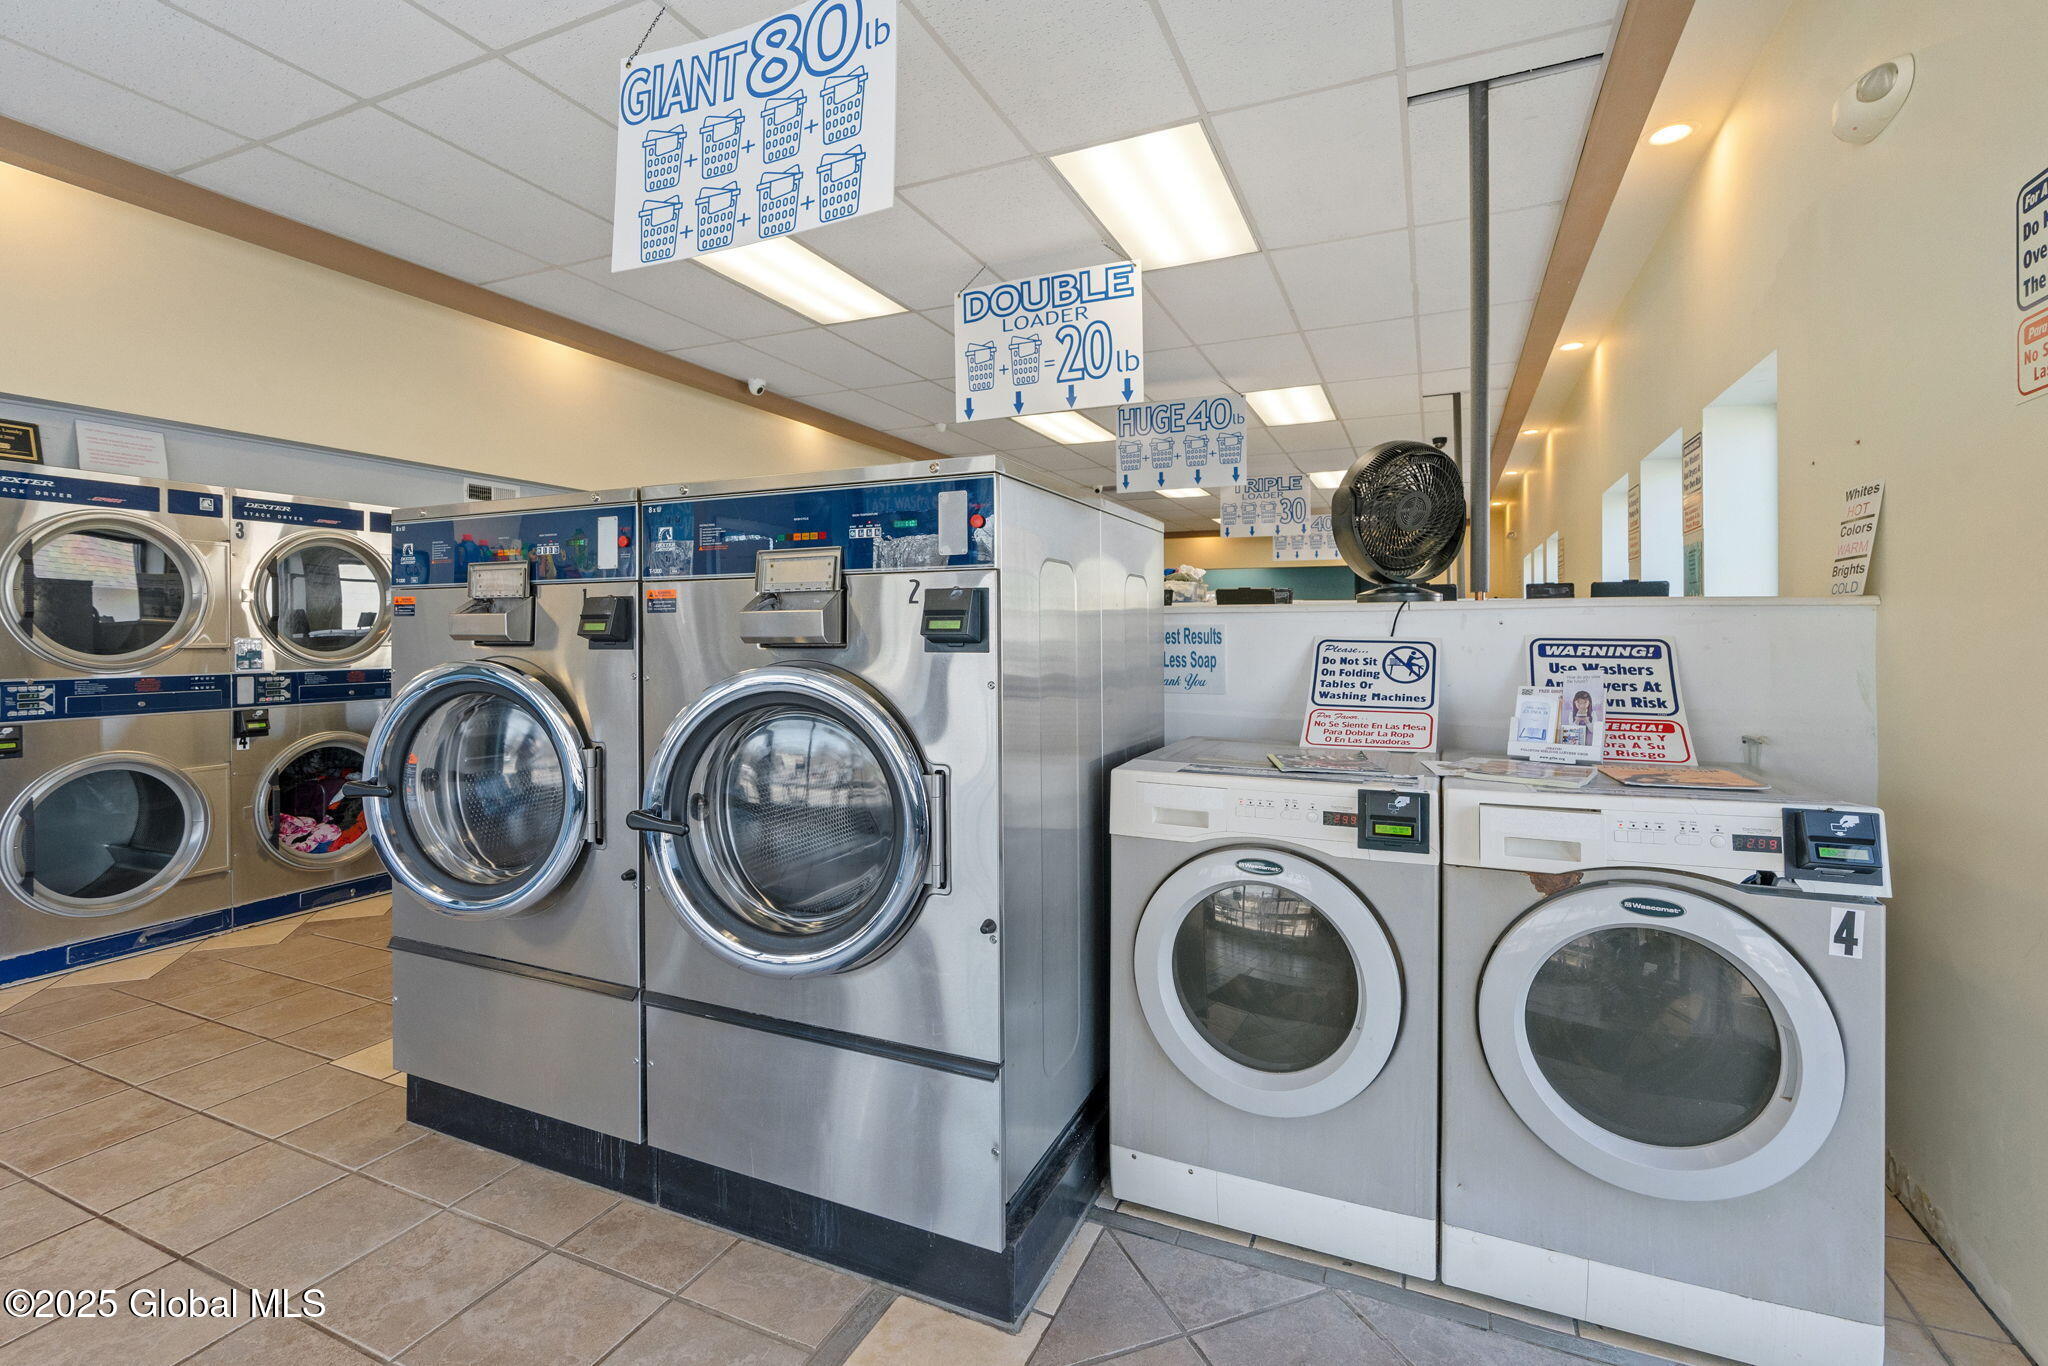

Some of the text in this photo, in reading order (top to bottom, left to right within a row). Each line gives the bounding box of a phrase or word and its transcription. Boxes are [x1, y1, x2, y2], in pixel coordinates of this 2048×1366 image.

[621, 0, 891, 125] GIANT 80 lb
[2023, 219, 2039, 242] Do
[2023, 243, 2047, 269] Ove
[2023, 273, 2047, 298] The
[963, 264, 1134, 324] DOUBLE
[1002, 306, 1088, 332] LOADER
[1055, 320, 1140, 383] 20 lb
[2024, 350, 2039, 366] No
[1118, 403, 1185, 437] HUGE
[1186, 398, 1232, 430] 40
[0, 475, 54, 487] EXTER
[35, 490, 73, 499] DRYER
[1242, 491, 1284, 500] LOADER
[1845, 482, 1880, 502] Whites
[244, 502, 292, 512] DEXTER
[1280, 497, 1306, 524] 30
[1847, 502, 1871, 517] HOT
[235, 521, 245, 540] 3
[1840, 521, 1873, 538] Colors
[1837, 540, 1869, 556] WARM
[1832, 563, 1865, 579] Brights
[908, 579, 920, 604] 2
[1832, 581, 1859, 595] COLD
[1165, 627, 1222, 645] est Results
[1544, 645, 1656, 658] WARNING!
[1190, 650, 1217, 672] Soap
[1322, 656, 1378, 666] Do Not Sit
[1321, 668, 1381, 679] On Folding
[1548, 662, 1654, 676] Use Washers
[1163, 672, 1207, 690] ank You
[1319, 679, 1374, 689] Tables Or
[1545, 678, 1663, 693] An yers At
[1318, 691, 1427, 703] Washing Machines
[1630, 696, 1669, 709] Risk
[1322, 728, 1343, 736] Para
[1344, 729, 1375, 737] Doblar
[1390, 731, 1415, 739] Ropa
[1341, 721, 1369, 729] Siente
[1402, 723, 1427, 731] Mesa
[239, 736, 248, 749] 4
[1364, 738, 1411, 746] Lavadoras
[1632, 742, 1642, 750] A
[1647, 743, 1666, 751] Su
[1615, 749, 1666, 760] Riesgo
[1631, 902, 1682, 915] Wascomat
[1832, 910, 1860, 957] 4
